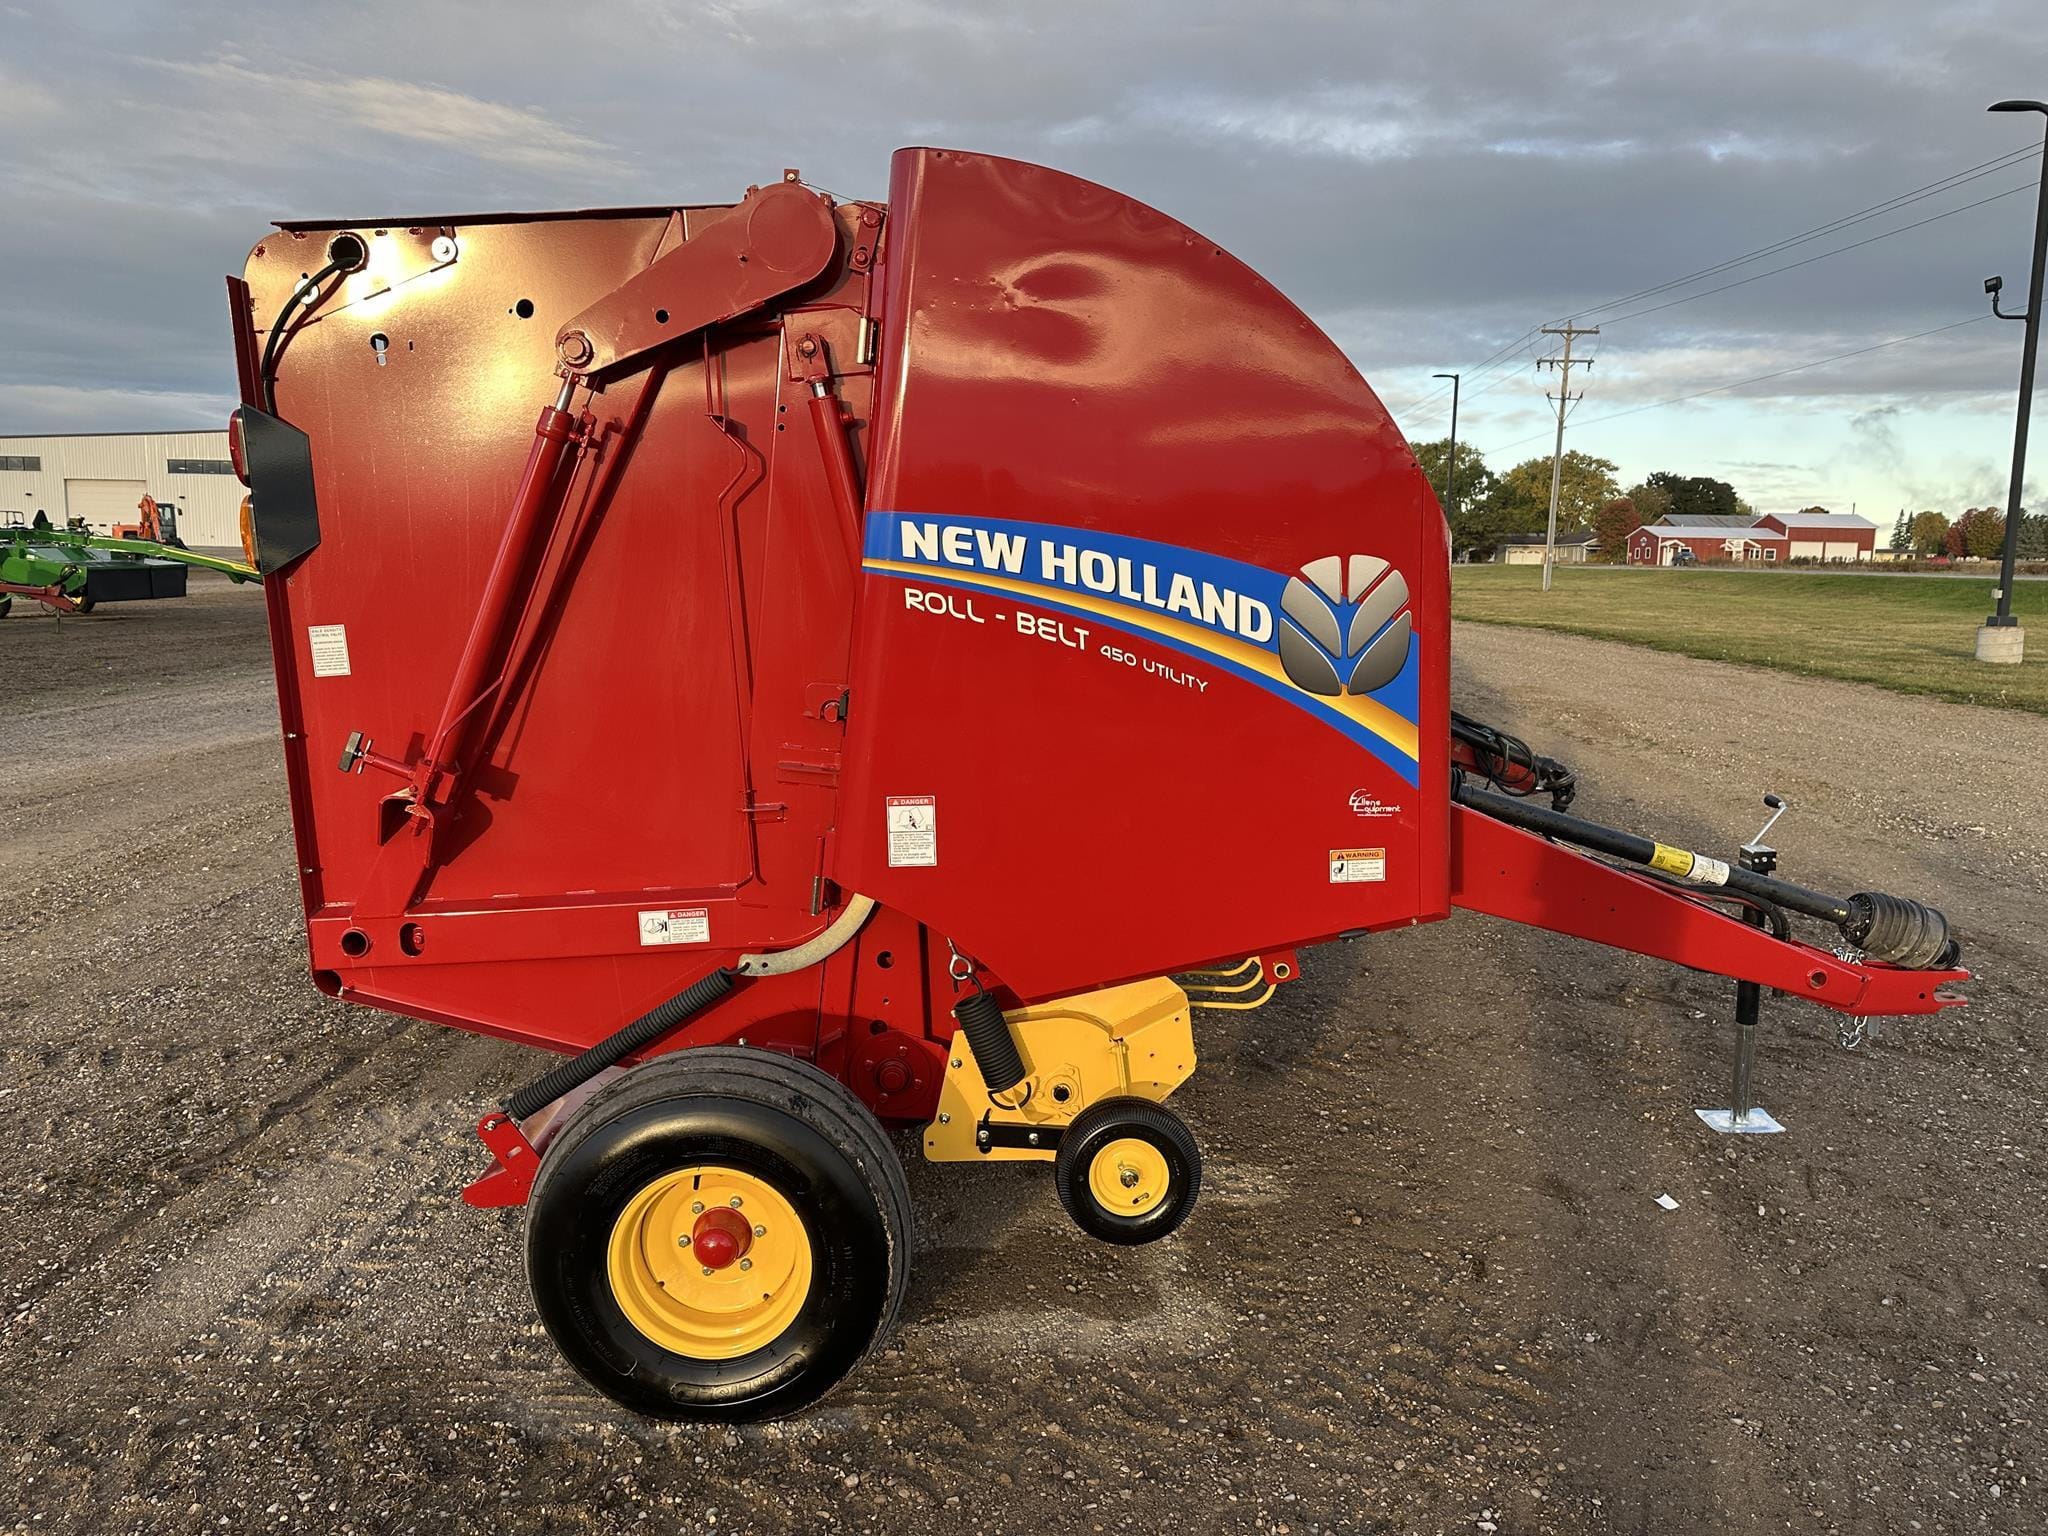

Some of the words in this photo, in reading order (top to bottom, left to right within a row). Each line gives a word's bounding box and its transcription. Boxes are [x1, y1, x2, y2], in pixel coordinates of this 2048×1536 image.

[901, 521, 1027, 574] NEW
[1040, 540, 1273, 643] HOLLAND
[905, 587, 985, 624] ROLL
[1016, 611, 1090, 650] BELT
[1100, 645, 1137, 667] 450
[1143, 658, 1209, 693] UTILITY
[1345, 851, 1380, 859] WARNING
[677, 910, 705, 918] DANGER
